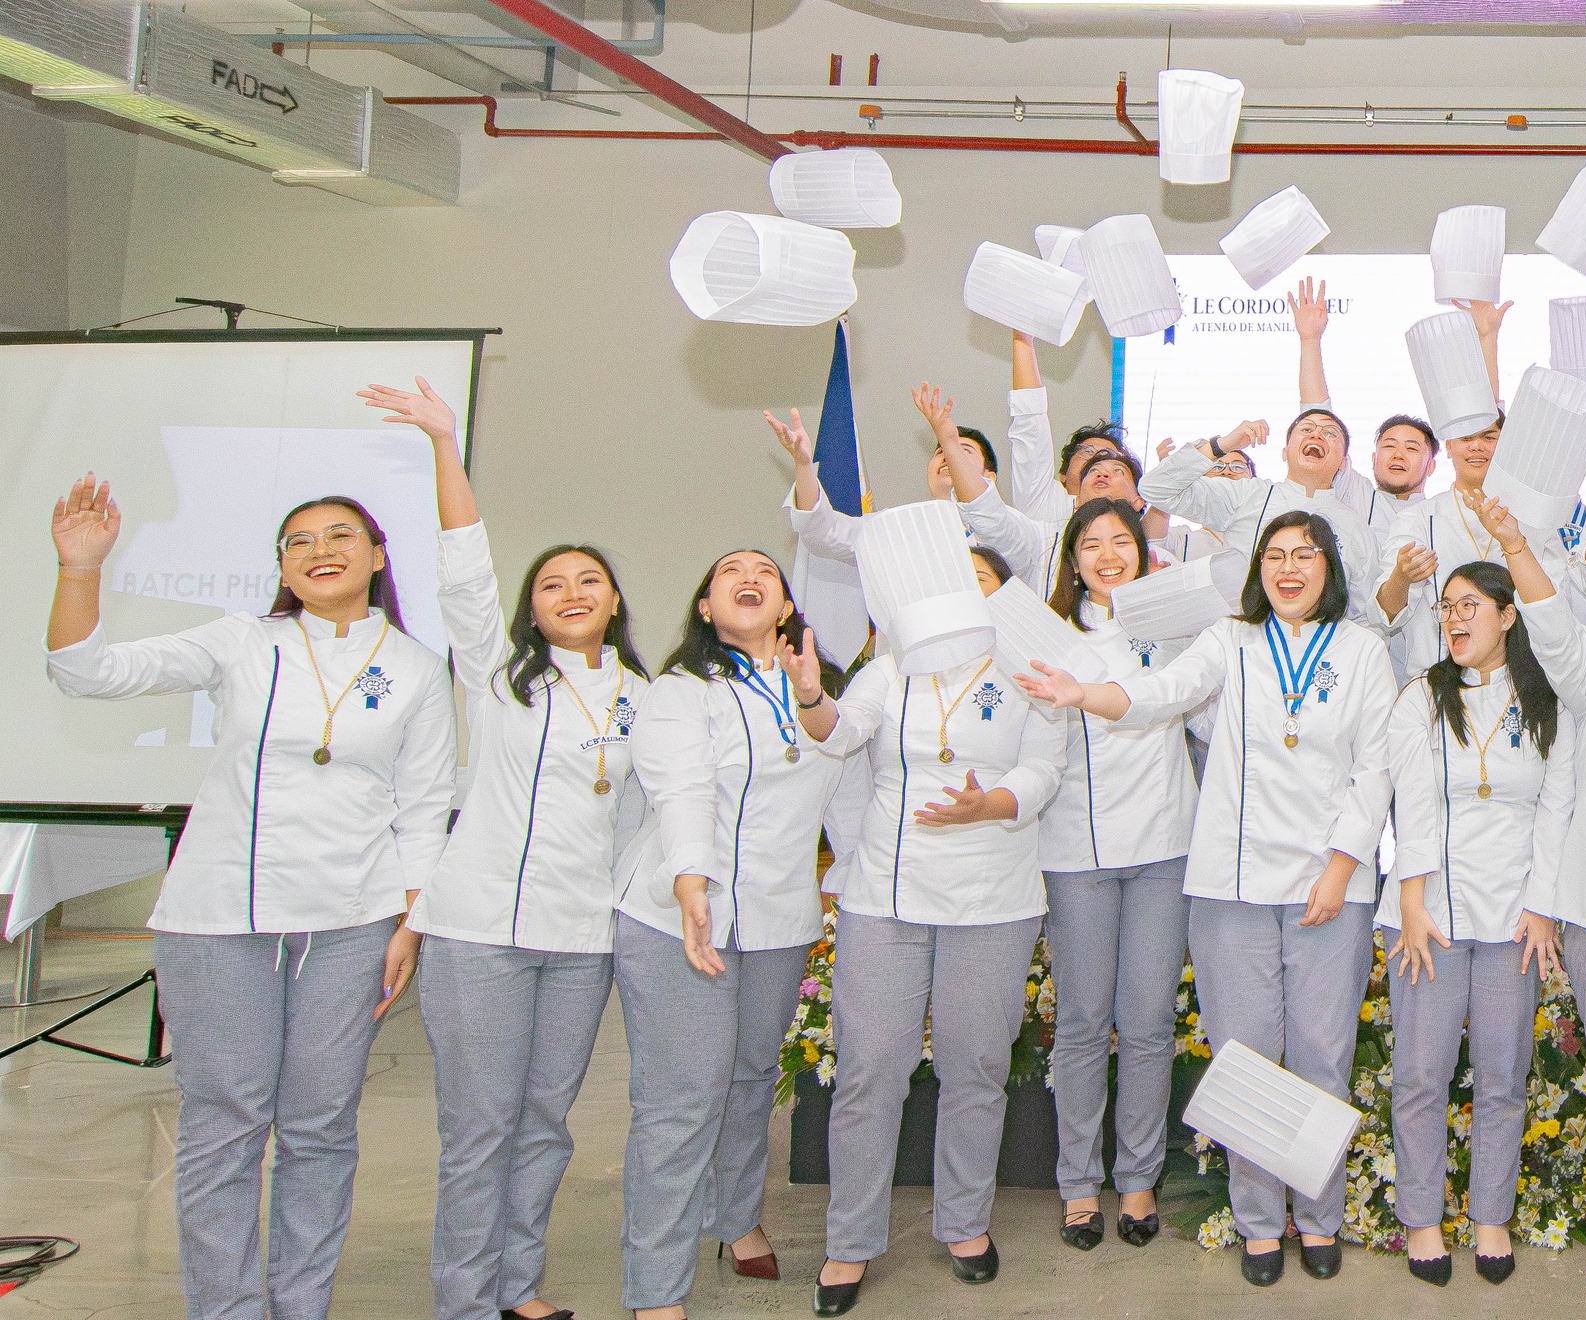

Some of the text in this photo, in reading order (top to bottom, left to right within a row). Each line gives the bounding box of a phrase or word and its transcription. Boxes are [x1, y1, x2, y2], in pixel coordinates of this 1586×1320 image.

[212, 59, 259, 99] FAD
[1192, 297, 1215, 315] LE
[1192, 322, 1237, 332] ATENEO
[1239, 322, 1254, 332] DE
[123, 571, 216, 598] BATCH
